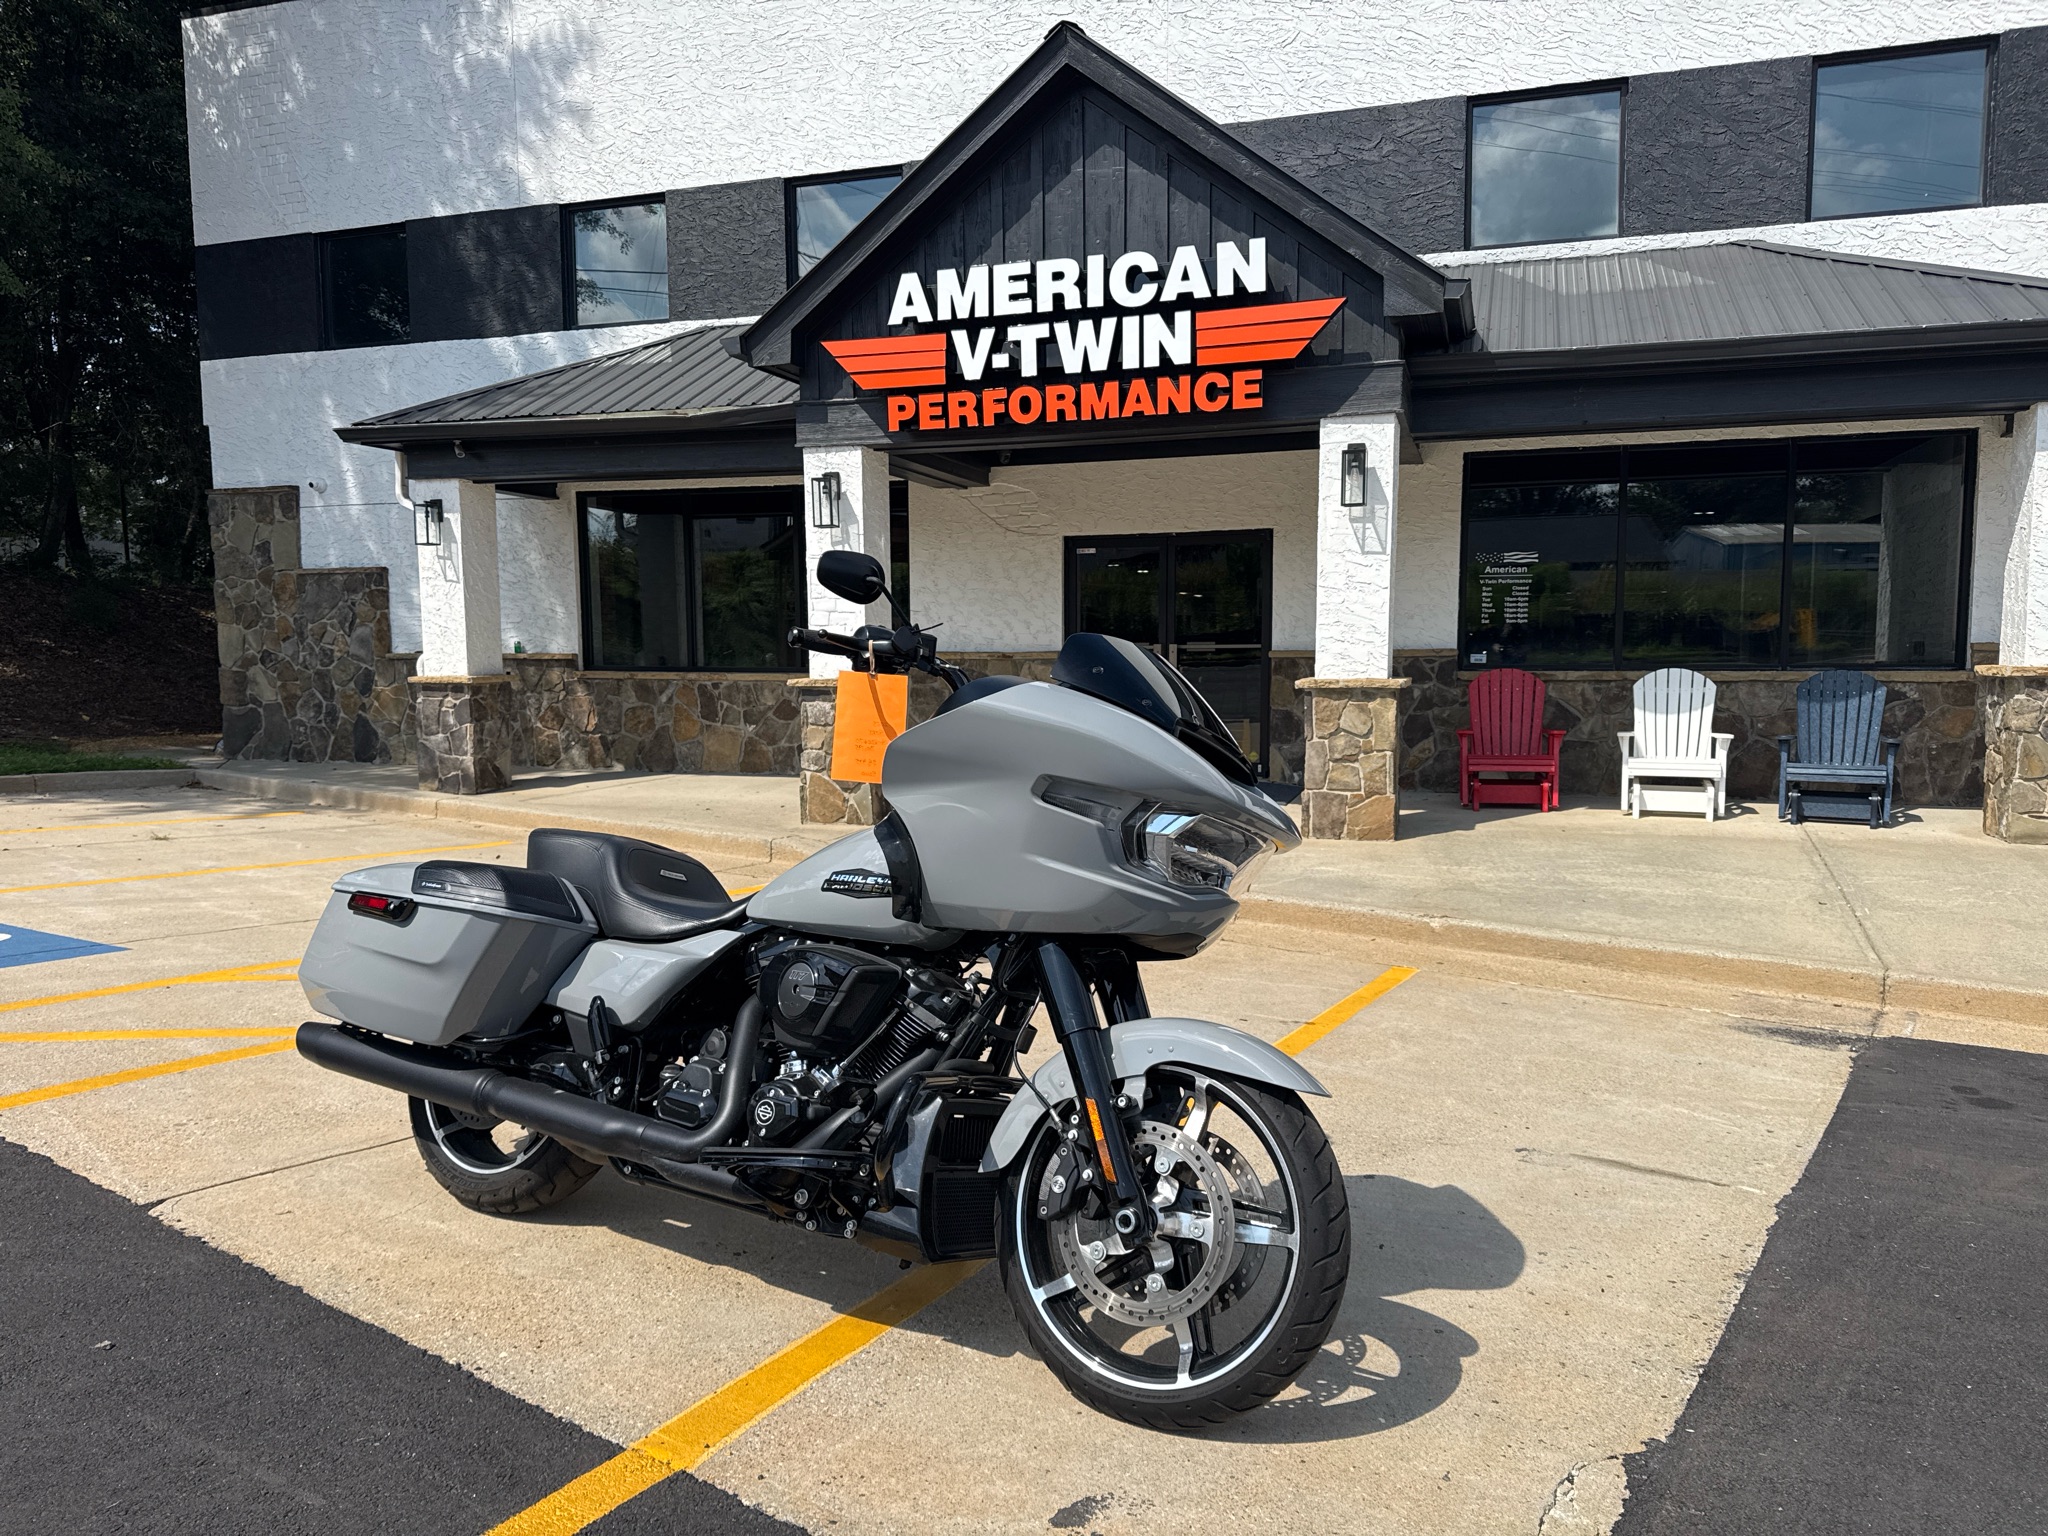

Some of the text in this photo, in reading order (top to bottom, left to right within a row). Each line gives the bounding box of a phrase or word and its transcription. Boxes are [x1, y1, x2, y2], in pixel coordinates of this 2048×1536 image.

[887, 236, 1267, 326] AMERICAN
[949, 310, 1192, 381] V-TWIN
[887, 369, 1264, 432] PERFORMANCE
